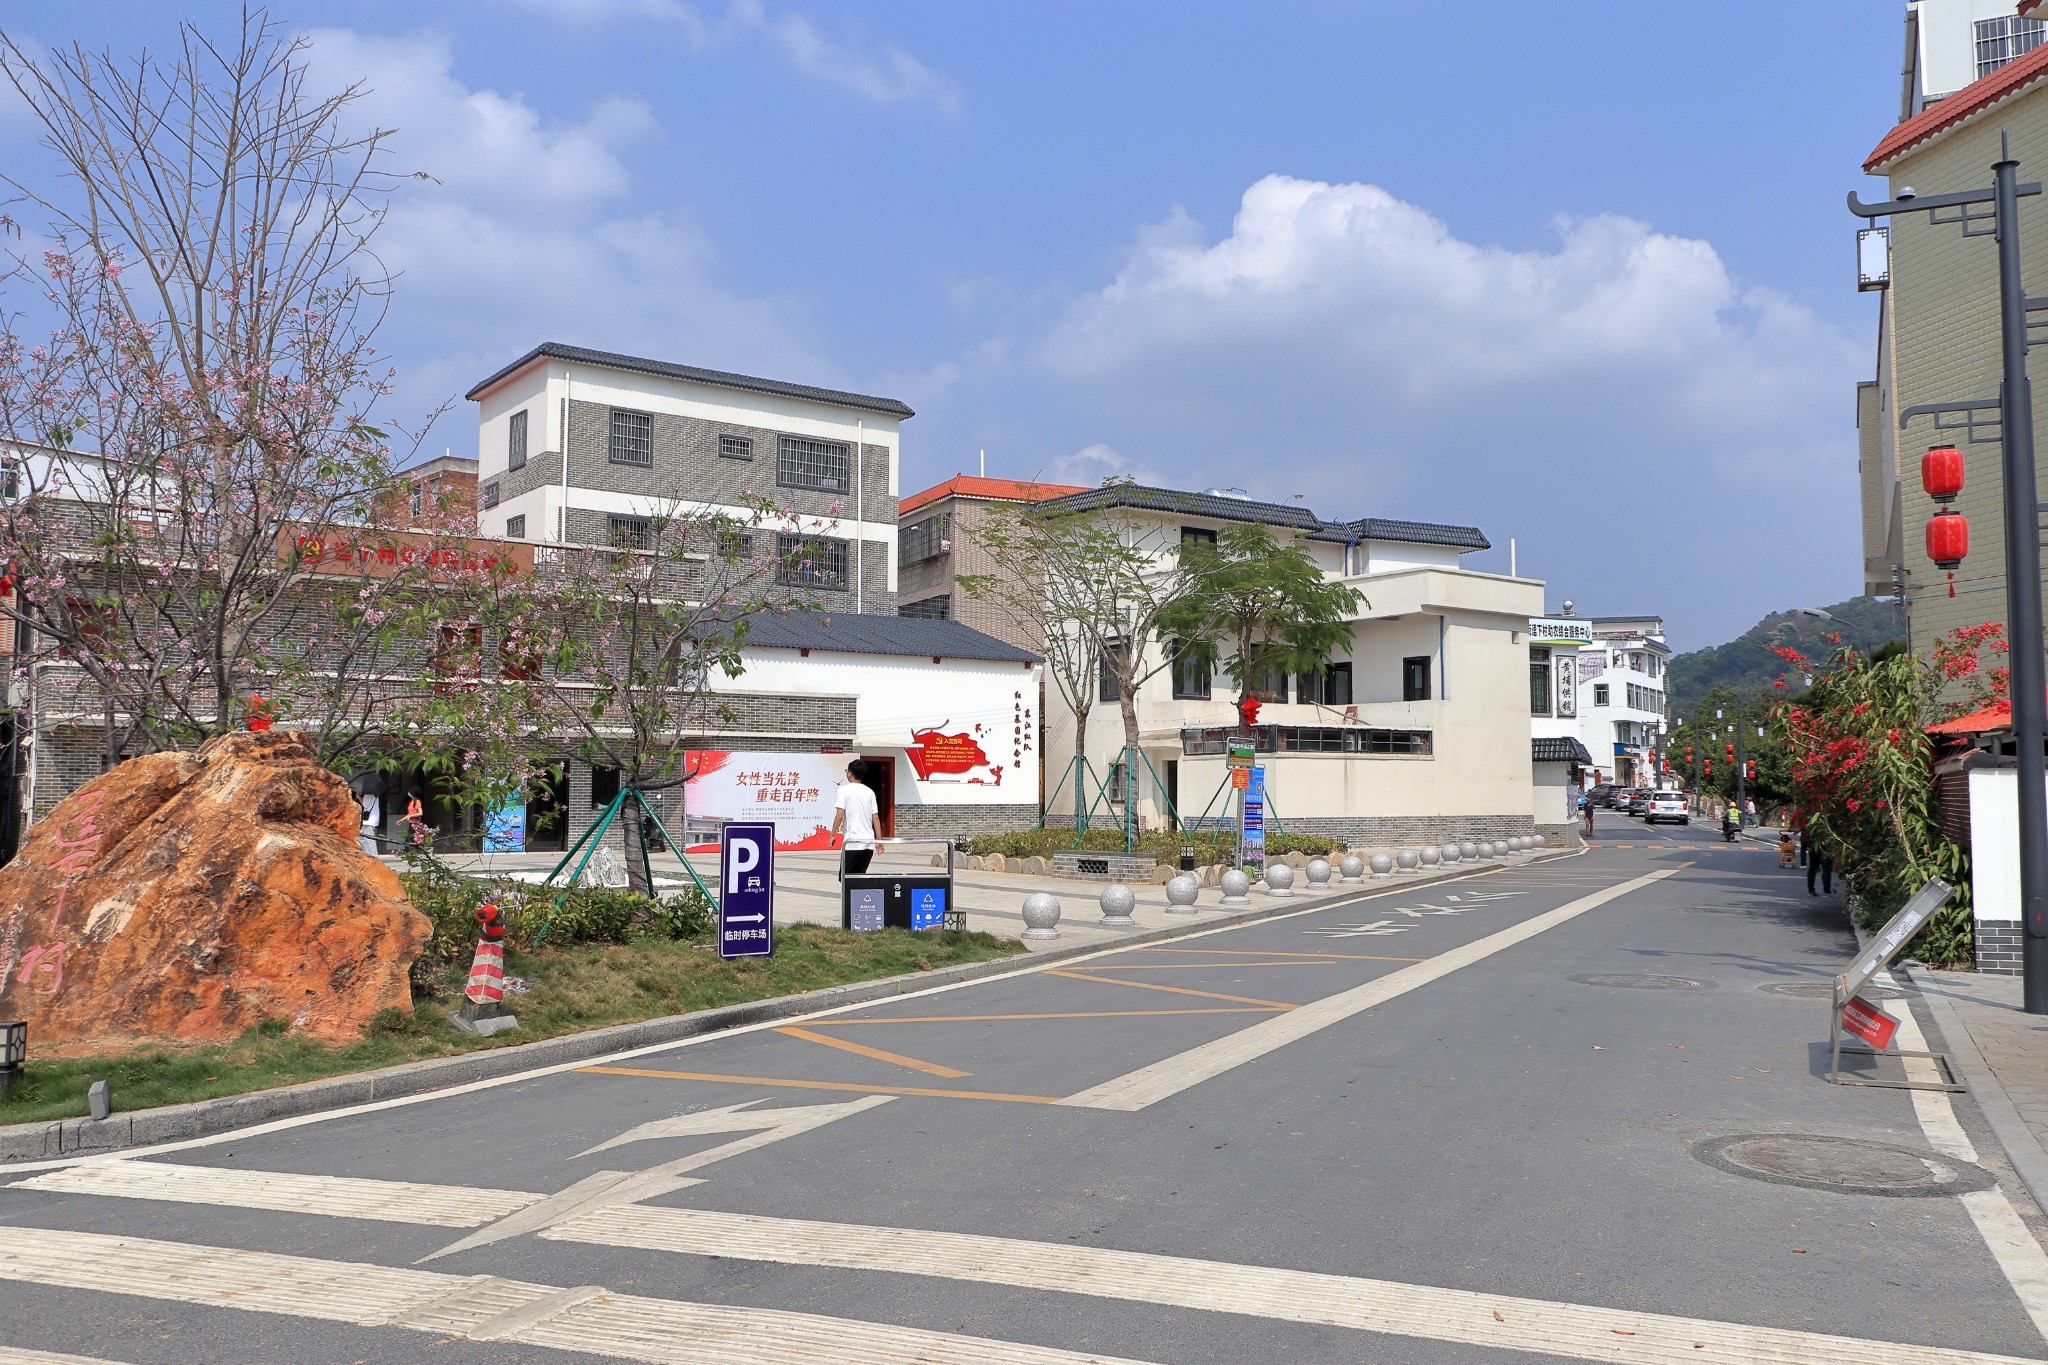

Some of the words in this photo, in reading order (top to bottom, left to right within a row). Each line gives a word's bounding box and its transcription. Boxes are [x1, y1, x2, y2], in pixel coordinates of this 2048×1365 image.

[735, 771, 800, 787] 女性当先锋
[755, 787, 820, 803] 重走百年路
[728, 837, 760, 894] P
[724, 928, 767, 941] 临时停车场
